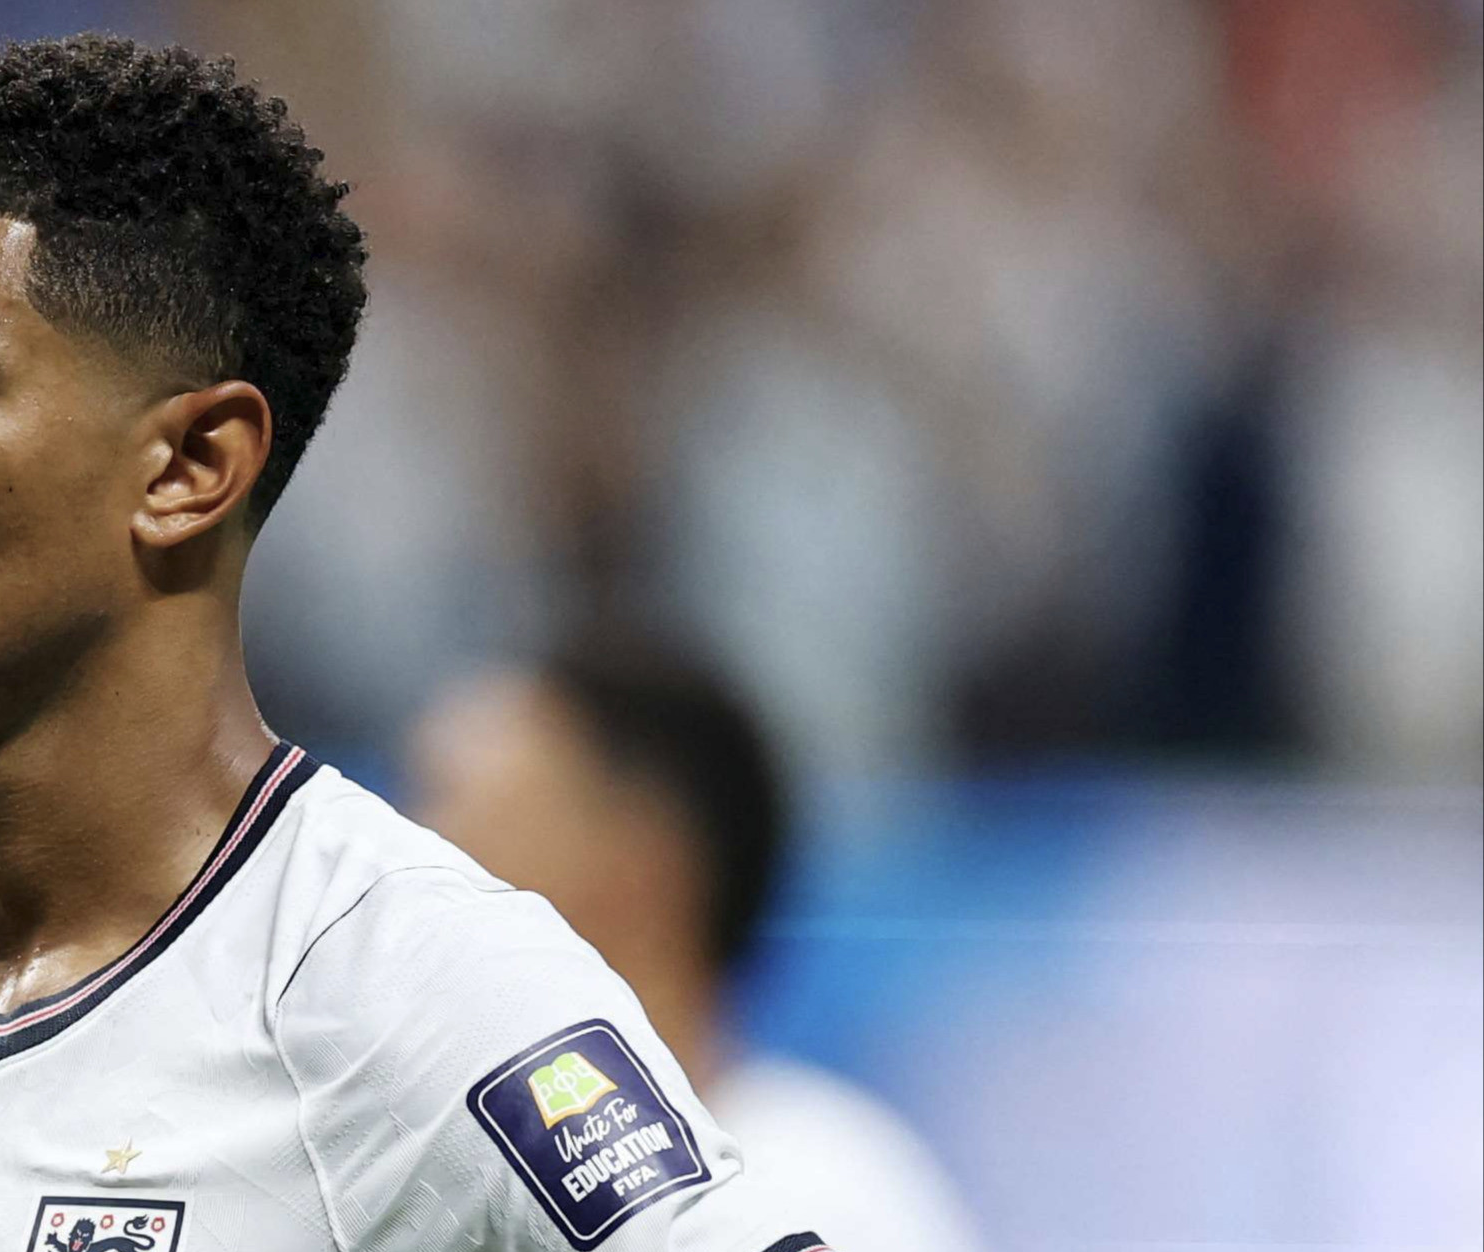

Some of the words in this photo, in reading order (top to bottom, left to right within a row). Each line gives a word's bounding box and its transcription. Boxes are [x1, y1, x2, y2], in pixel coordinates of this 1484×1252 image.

[554, 1115, 611, 1163] Unite
[604, 1097, 638, 1131] For
[561, 1121, 674, 1203] EDUCATION
[611, 1165, 657, 1197] FIFA
